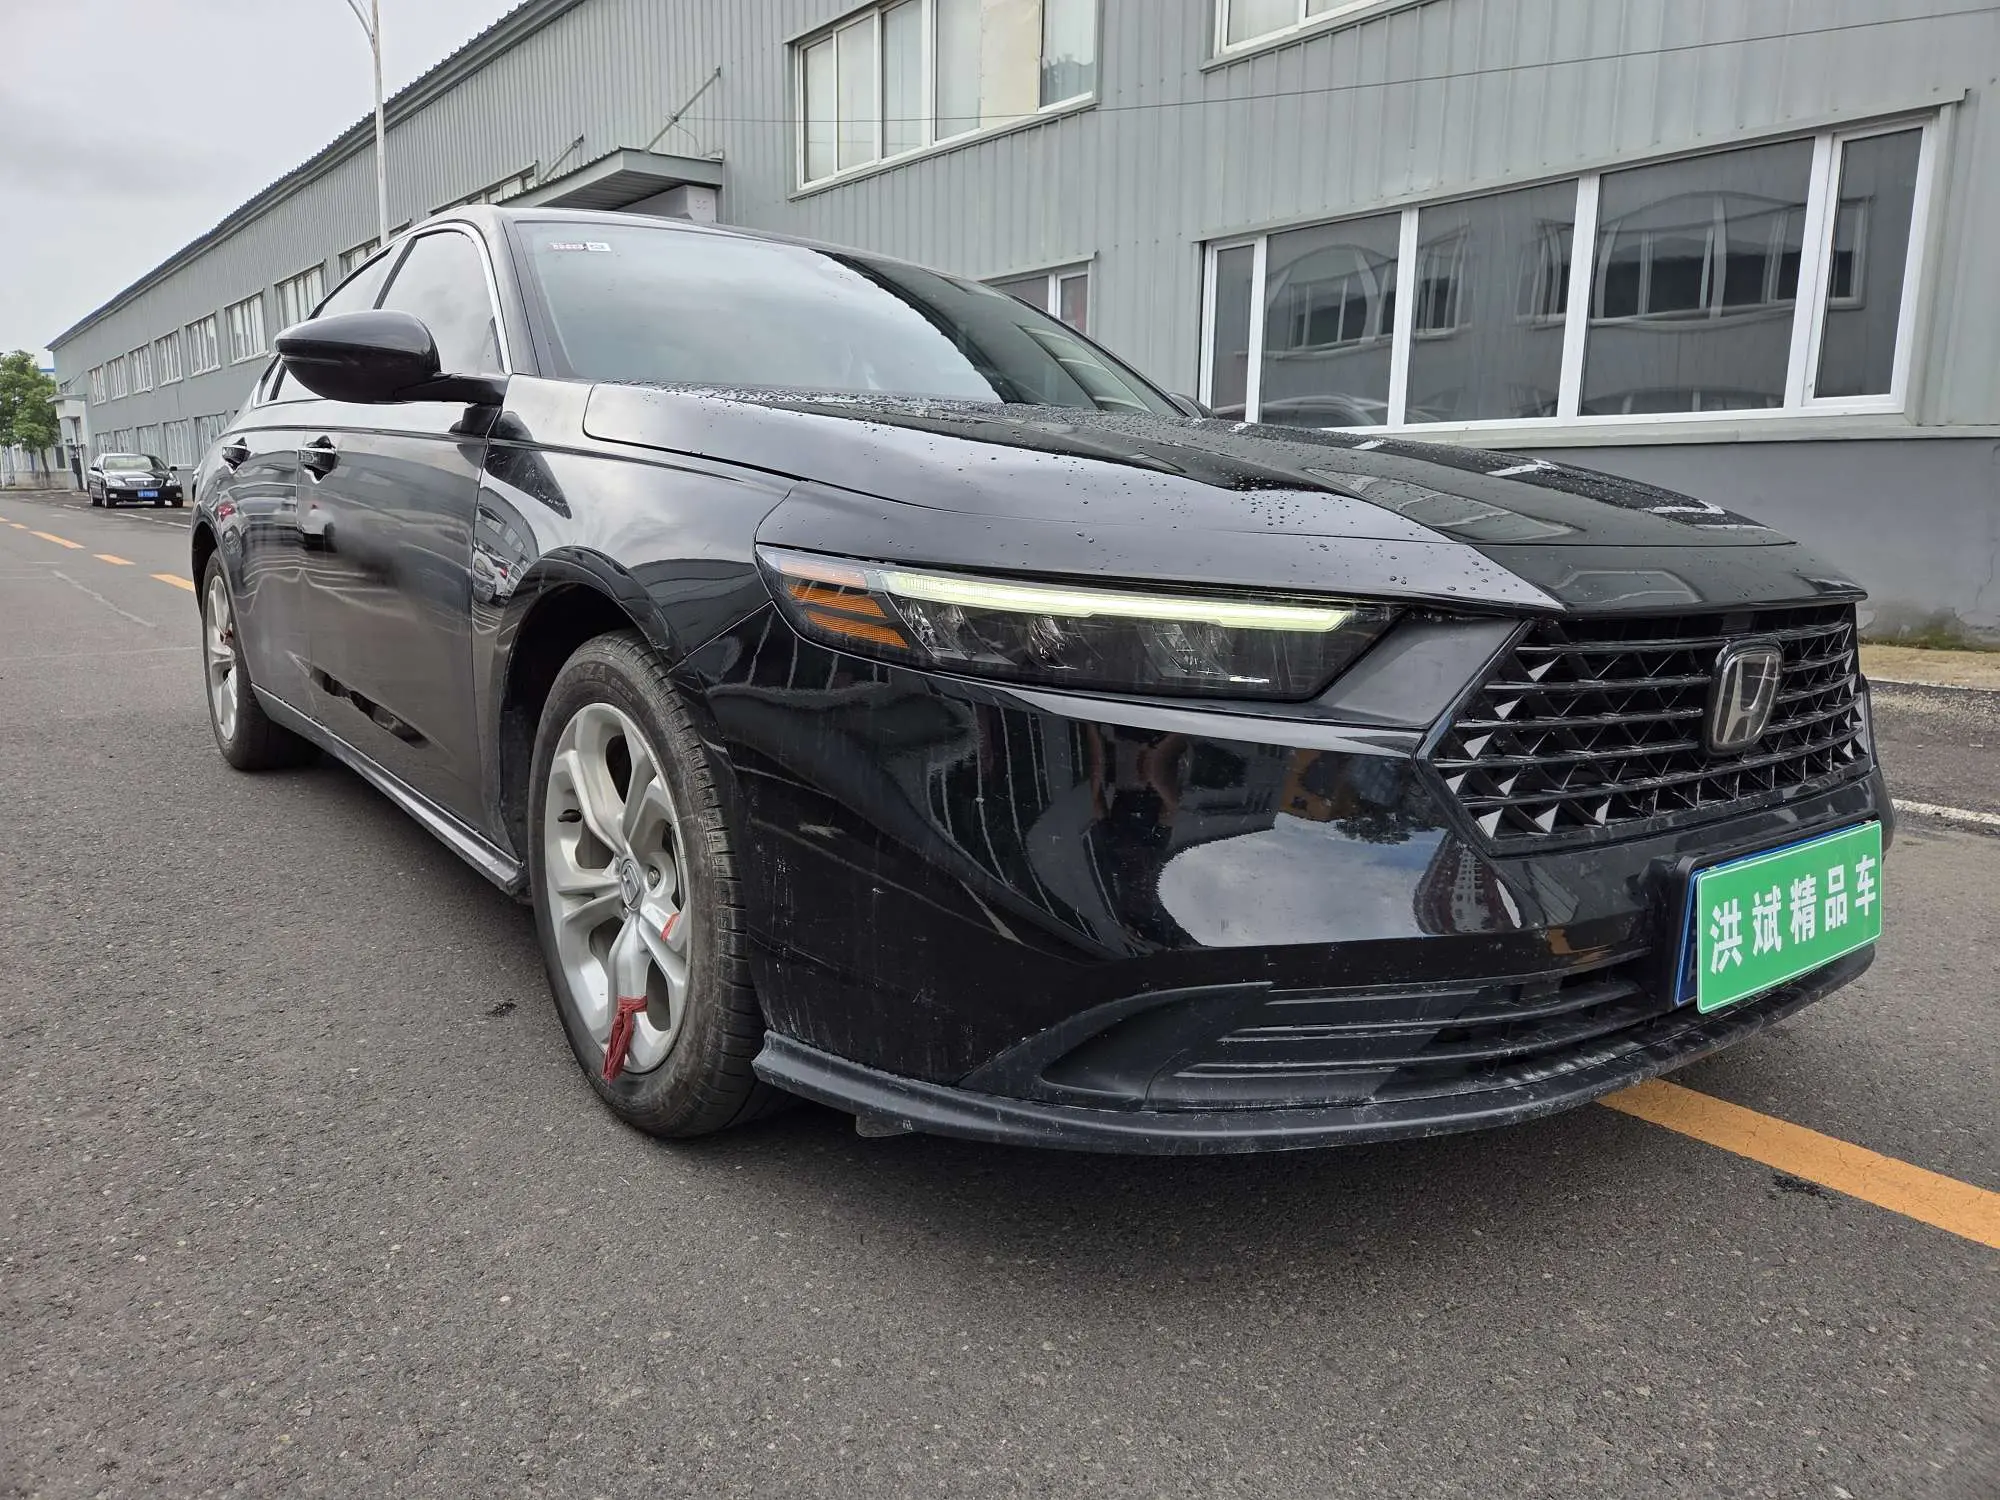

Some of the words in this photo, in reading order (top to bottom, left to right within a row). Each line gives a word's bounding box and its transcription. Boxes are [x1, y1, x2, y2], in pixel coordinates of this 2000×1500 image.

[1709, 854, 1876, 975] 洪斌精品车
